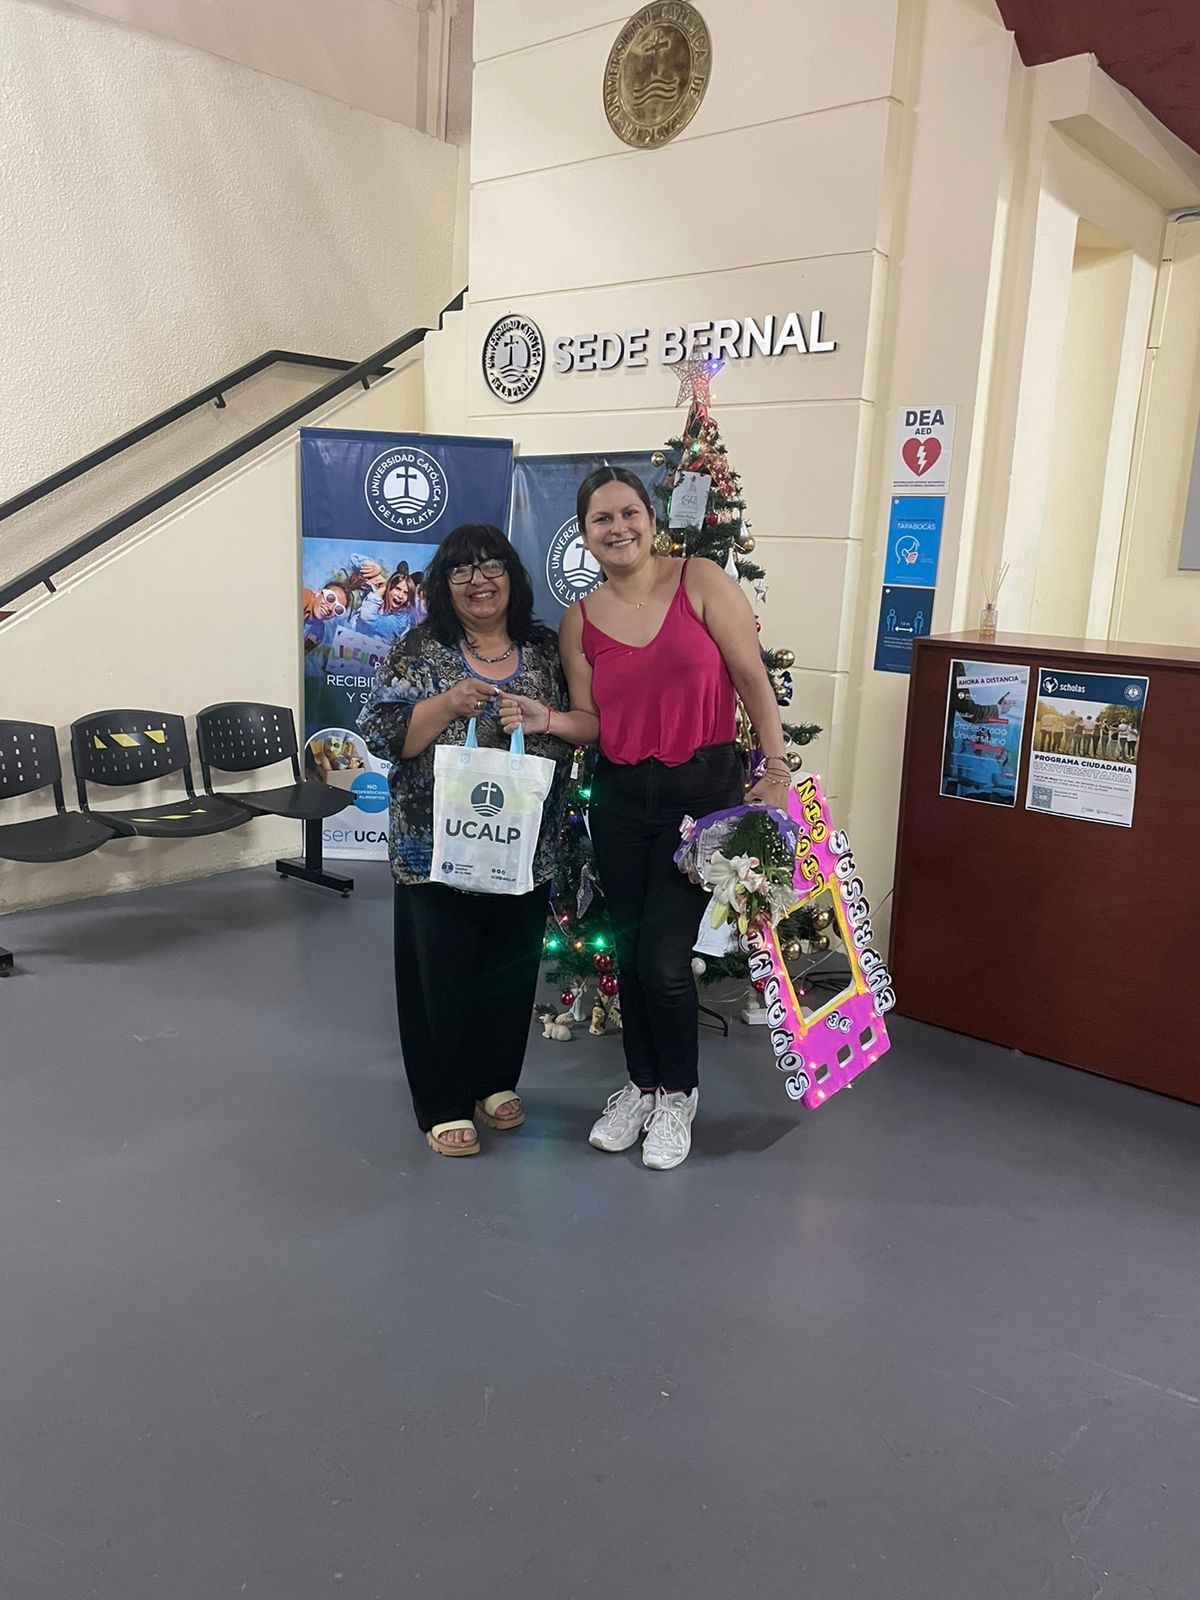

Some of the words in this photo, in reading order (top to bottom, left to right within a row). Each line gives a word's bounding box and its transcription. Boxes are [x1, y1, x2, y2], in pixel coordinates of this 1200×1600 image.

[552, 328, 649, 373] SEDE
[660, 310, 837, 364] BERNAL
[905, 409, 944, 426] DEA
[915, 427, 932, 435] AED
[371, 454, 415, 496] UNIVERSIDAD
[416, 458, 442, 502] CATÓLICA
[378, 504, 392, 518] DE
[391, 514, 404, 525] LA
[406, 508, 435, 526] PLATA
[897, 522, 936, 530] TAPABOCAS
[555, 578, 567, 595] DE
[565, 589, 577, 602] LA
[958, 677, 980, 686] AHORA
[986, 675, 1019, 684] DISTANCIA
[1059, 683, 1086, 693] scholas
[346, 692, 356, 703] Y
[1033, 761, 1132, 784] UNIVERSITARIA
[1034, 754, 1079, 766] PROGRAMA
[1081, 760, 1132, 774] CIUDADANÍA
[445, 818, 521, 845] UCALP
[828, 828, 896, 1016] EMPRESAS
[825, 1010, 853, 1034] DE
[770, 1027, 811, 1101] SOY
